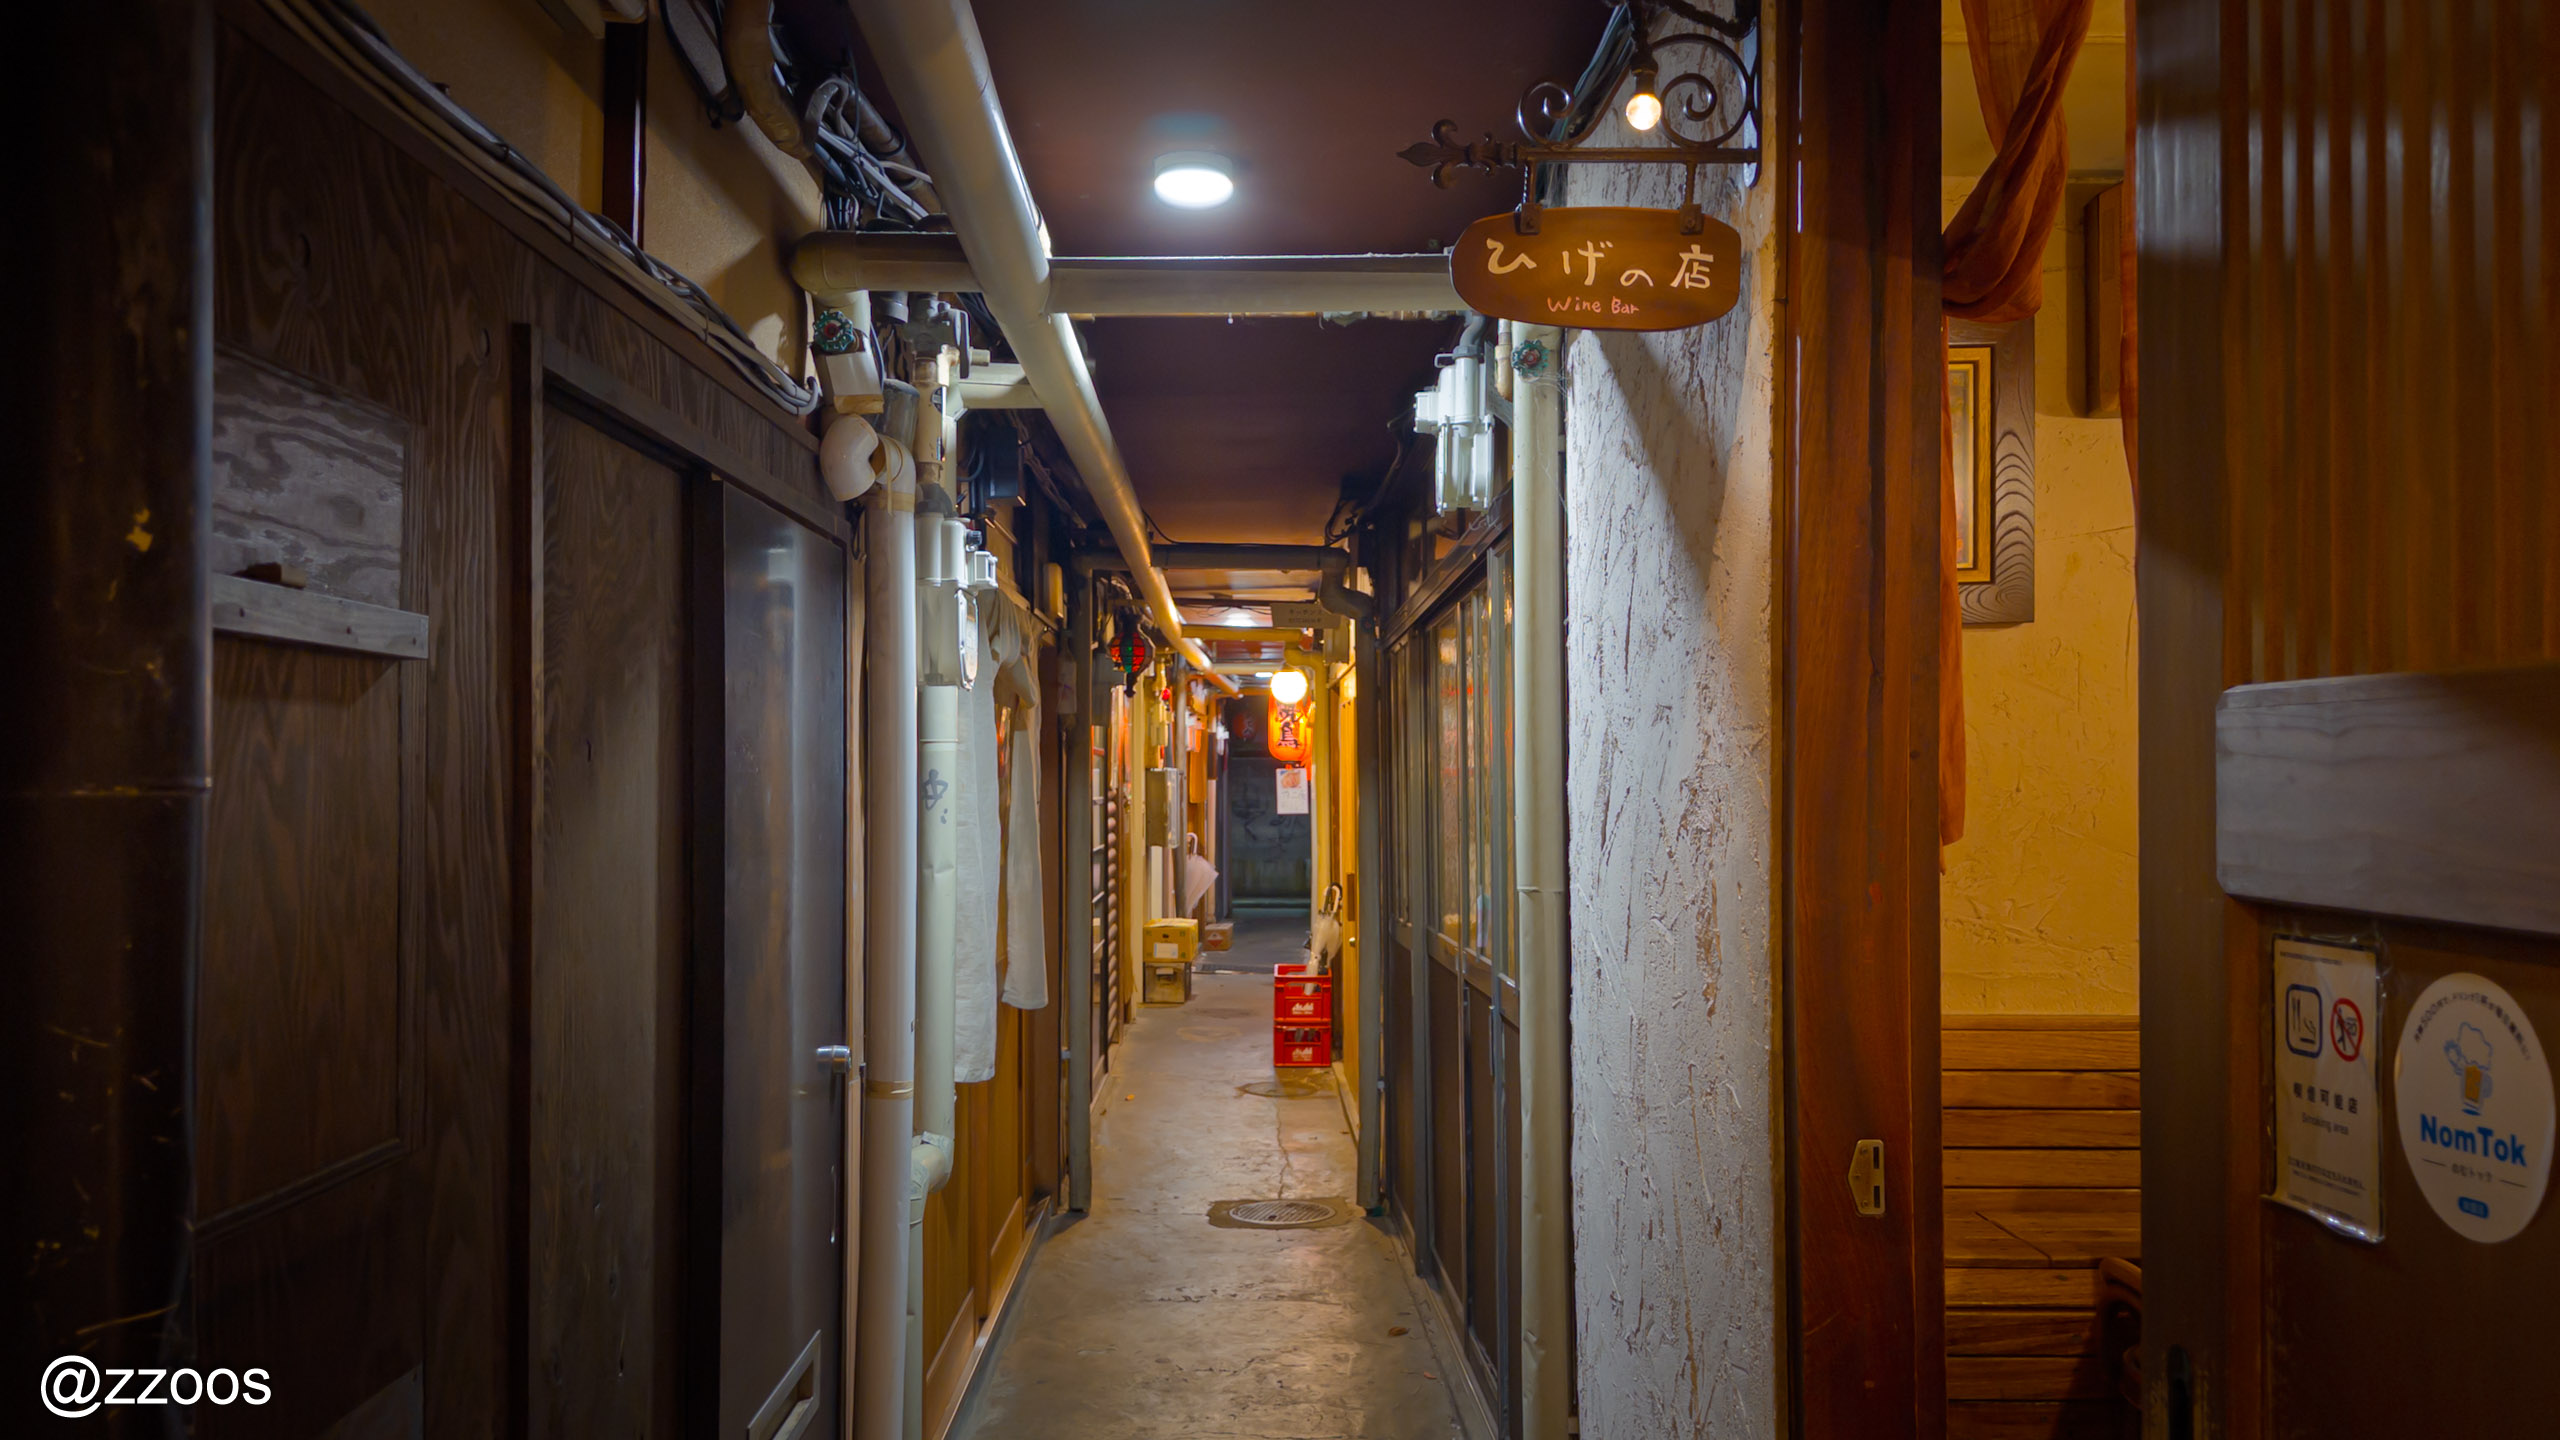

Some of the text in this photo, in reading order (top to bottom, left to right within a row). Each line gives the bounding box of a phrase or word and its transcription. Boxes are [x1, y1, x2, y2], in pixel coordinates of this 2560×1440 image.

[1486, 237, 1714, 289] ひげの店
[1547, 296, 1640, 315] Wine Bar
[2420, 1113, 2527, 1167] NomTok
